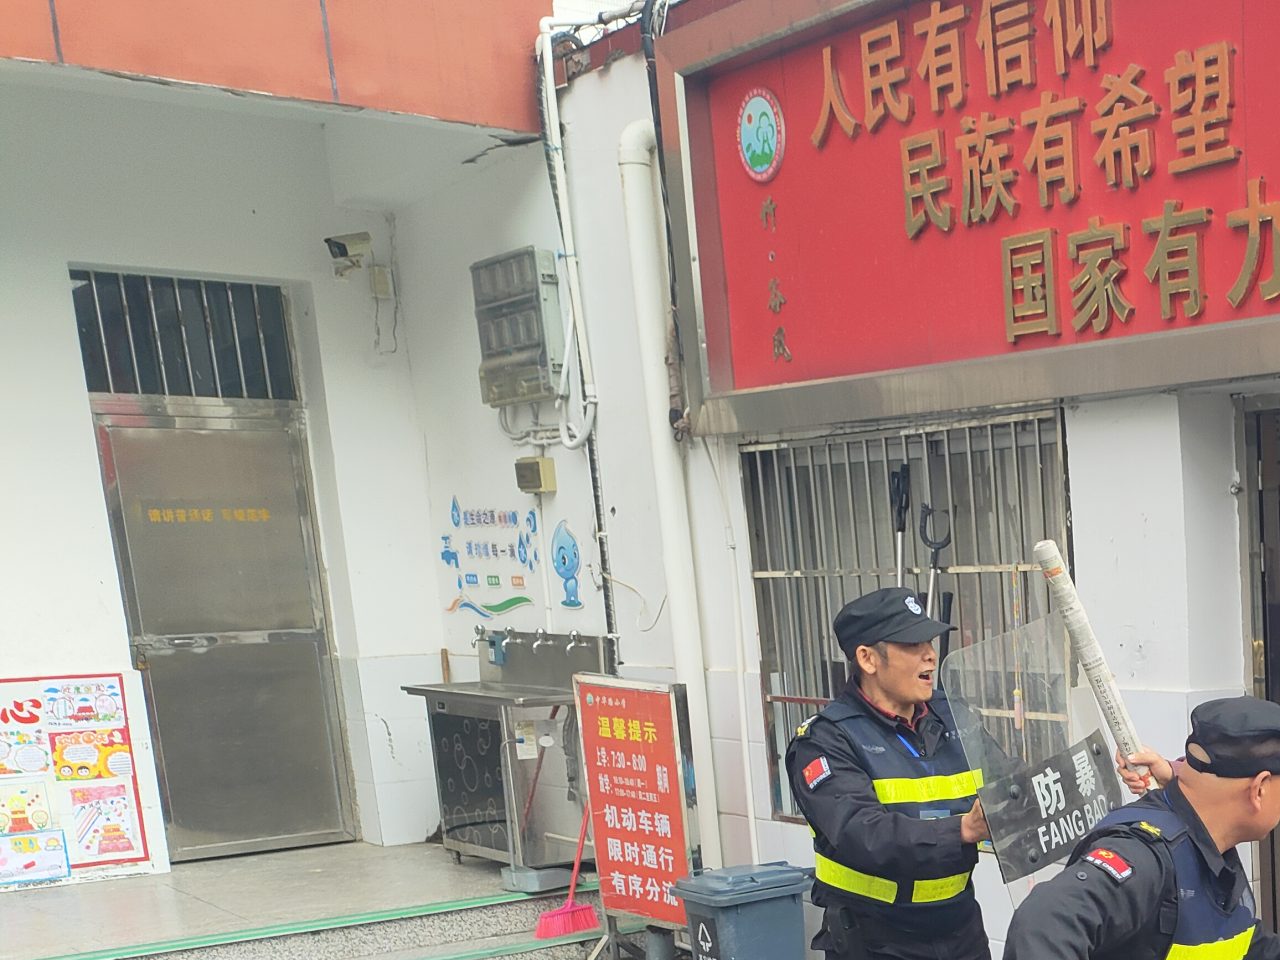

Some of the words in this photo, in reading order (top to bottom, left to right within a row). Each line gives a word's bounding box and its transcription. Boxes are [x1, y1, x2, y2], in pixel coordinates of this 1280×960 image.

[811, 0, 1113, 148] 人民有信仰
[904, 40, 1241, 239] 民族有希望
[597, 715, 657, 744] 温馨提示
[1032, 749, 1097, 819] 防暴
[604, 803, 672, 838] 机动车辆
[1037, 808, 1085, 854] FANG
[607, 838, 675, 873] 限时通行
[611, 872, 679, 907] 有序分流
